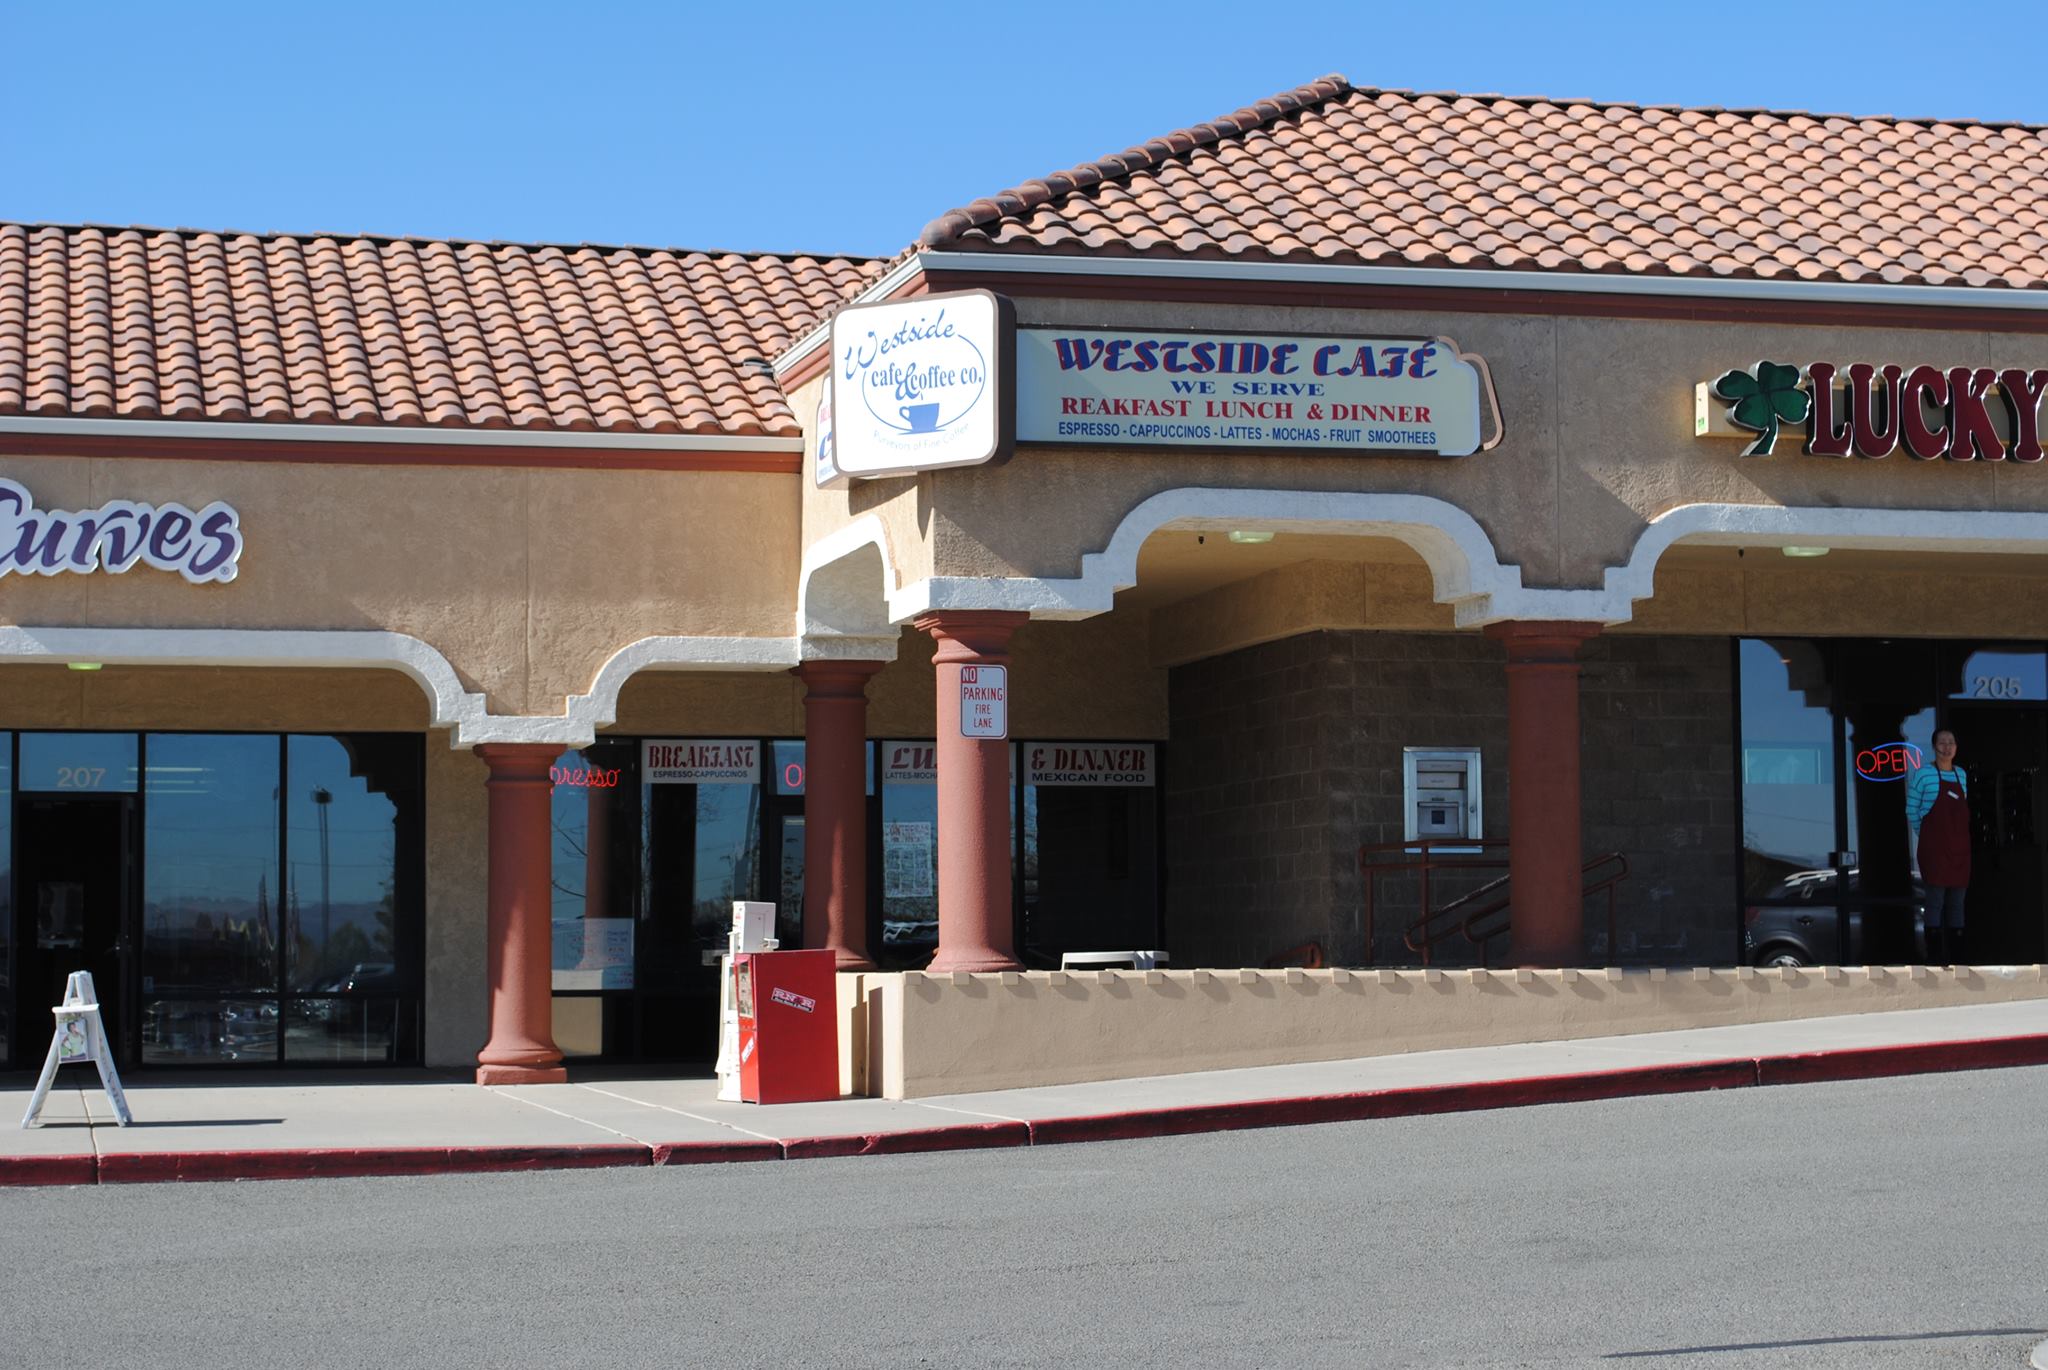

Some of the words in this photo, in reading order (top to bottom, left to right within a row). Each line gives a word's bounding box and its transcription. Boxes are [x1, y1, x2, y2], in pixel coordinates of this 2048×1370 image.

[844, 308, 955, 380] Westside
[1052, 338, 1299, 376] WESTSIDE
[871, 362, 902, 387] cafe
[910, 365, 955, 391] coffee
[960, 366, 982, 385] co.
[1170, 380, 1216, 395] WE
[1232, 381, 1325, 397] SERVE
[1061, 397, 1192, 418] REAKFAST
[1205, 400, 1294, 419] LUNCH
[1306, 403, 1324, 421] &
[1331, 403, 1432, 423] DINNER
[1807, 361, 2048, 464] LUCKY
[1058, 421, 1120, 437] ESPRESSO
[1129, 423, 1211, 439] CAPPUCCINOS
[1221, 425, 1262, 440] LATTES
[1272, 427, 1320, 442] MOCHAS
[1330, 428, 1361, 443] FRUIT
[962, 667, 976, 682] NO
[963, 687, 1003, 701] PARKING
[1974, 676, 2021, 699] 205
[975, 704, 992, 714] FIRE
[973, 718, 993, 728] LANE
[648, 745, 754, 768] BREAKFAST
[1053, 748, 1147, 771] DINNER
[1856, 749, 1921, 773] OPEN
[57, 767, 107, 788] 207
[549, 764, 621, 796] presso
[1032, 773, 1098, 782] MEXICAN
[1104, 773, 1145, 783] FOOD
